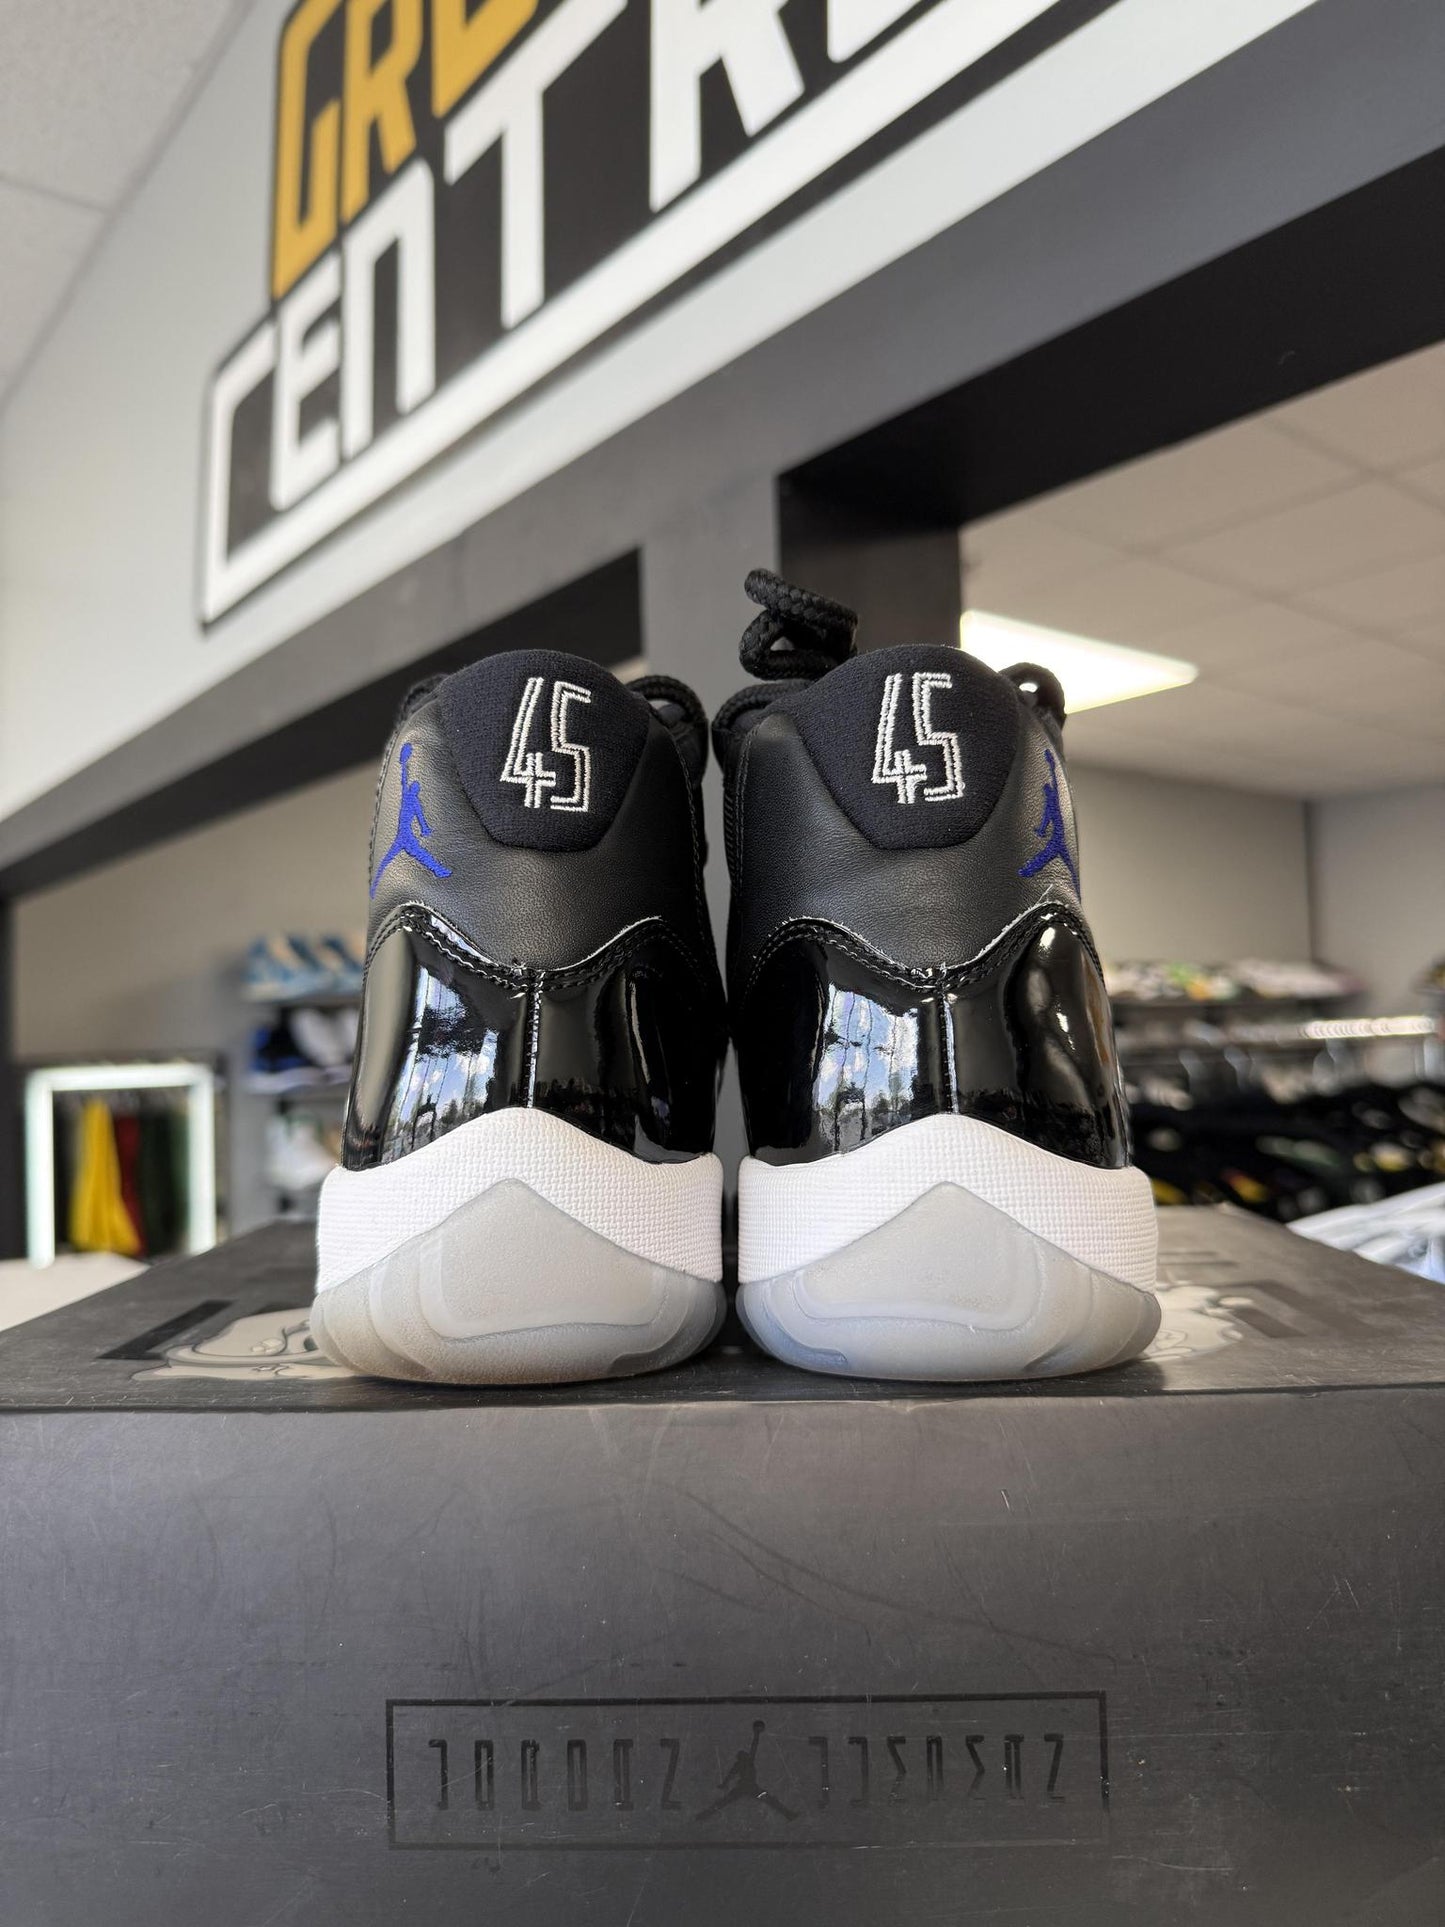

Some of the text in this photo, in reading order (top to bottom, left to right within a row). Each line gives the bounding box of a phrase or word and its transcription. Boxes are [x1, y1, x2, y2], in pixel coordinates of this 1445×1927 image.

[203, 0, 926, 624] CENTR
[500, 676, 593, 813] 45
[871, 672, 970, 805] 45
